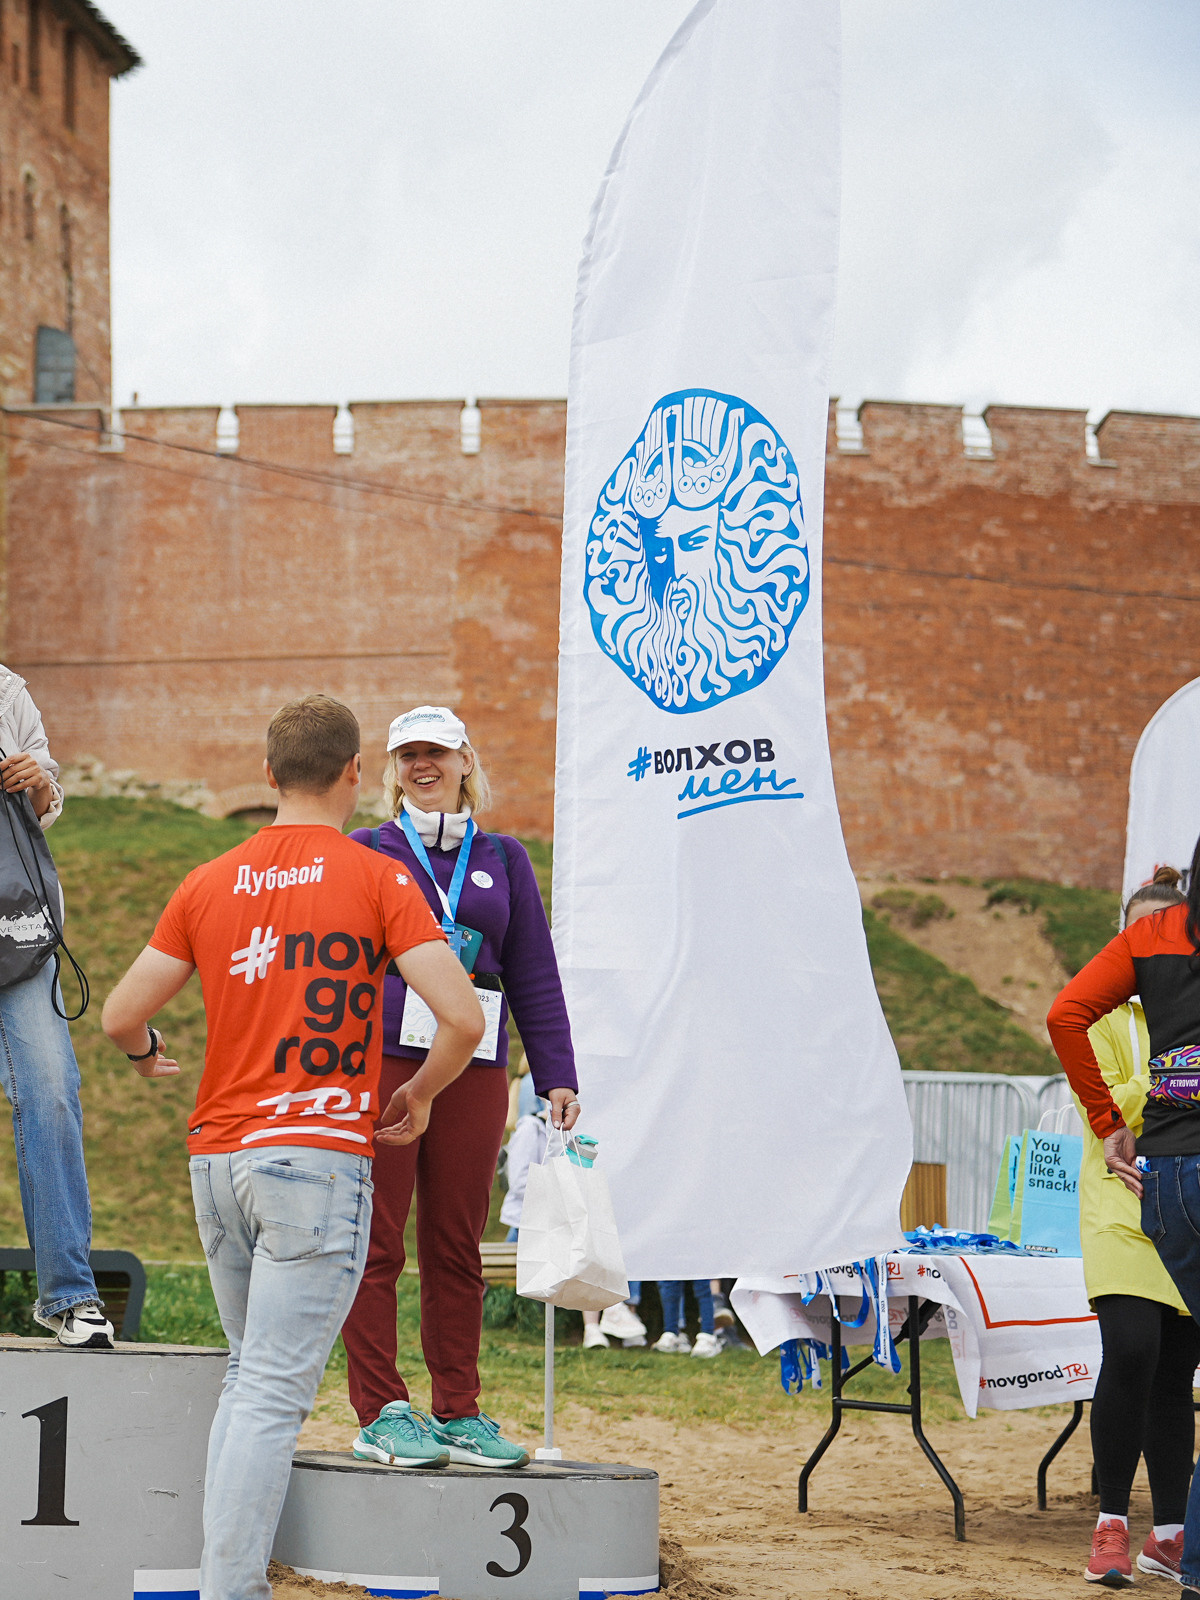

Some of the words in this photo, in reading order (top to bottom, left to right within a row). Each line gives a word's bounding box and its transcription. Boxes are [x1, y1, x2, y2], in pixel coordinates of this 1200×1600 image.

[233, 857, 324, 896] Дубовой
[0, 923, 42, 934] VERSTA
[229, 925, 386, 985] #nov
[303, 977, 377, 1033] go
[478, 994, 490, 1003] 023
[274, 1021, 373, 1077] rod
[1170, 1079, 1199, 1088] PETROVICH
[1032, 1137, 1060, 1153] You
[1031, 1150, 1061, 1166] look
[1029, 1162, 1055, 1177] like
[1058, 1169, 1067, 1179] a
[1028, 1178, 1076, 1193] snack!
[20, 1395, 80, 1527] 1
[486, 1492, 532, 1577] 3
